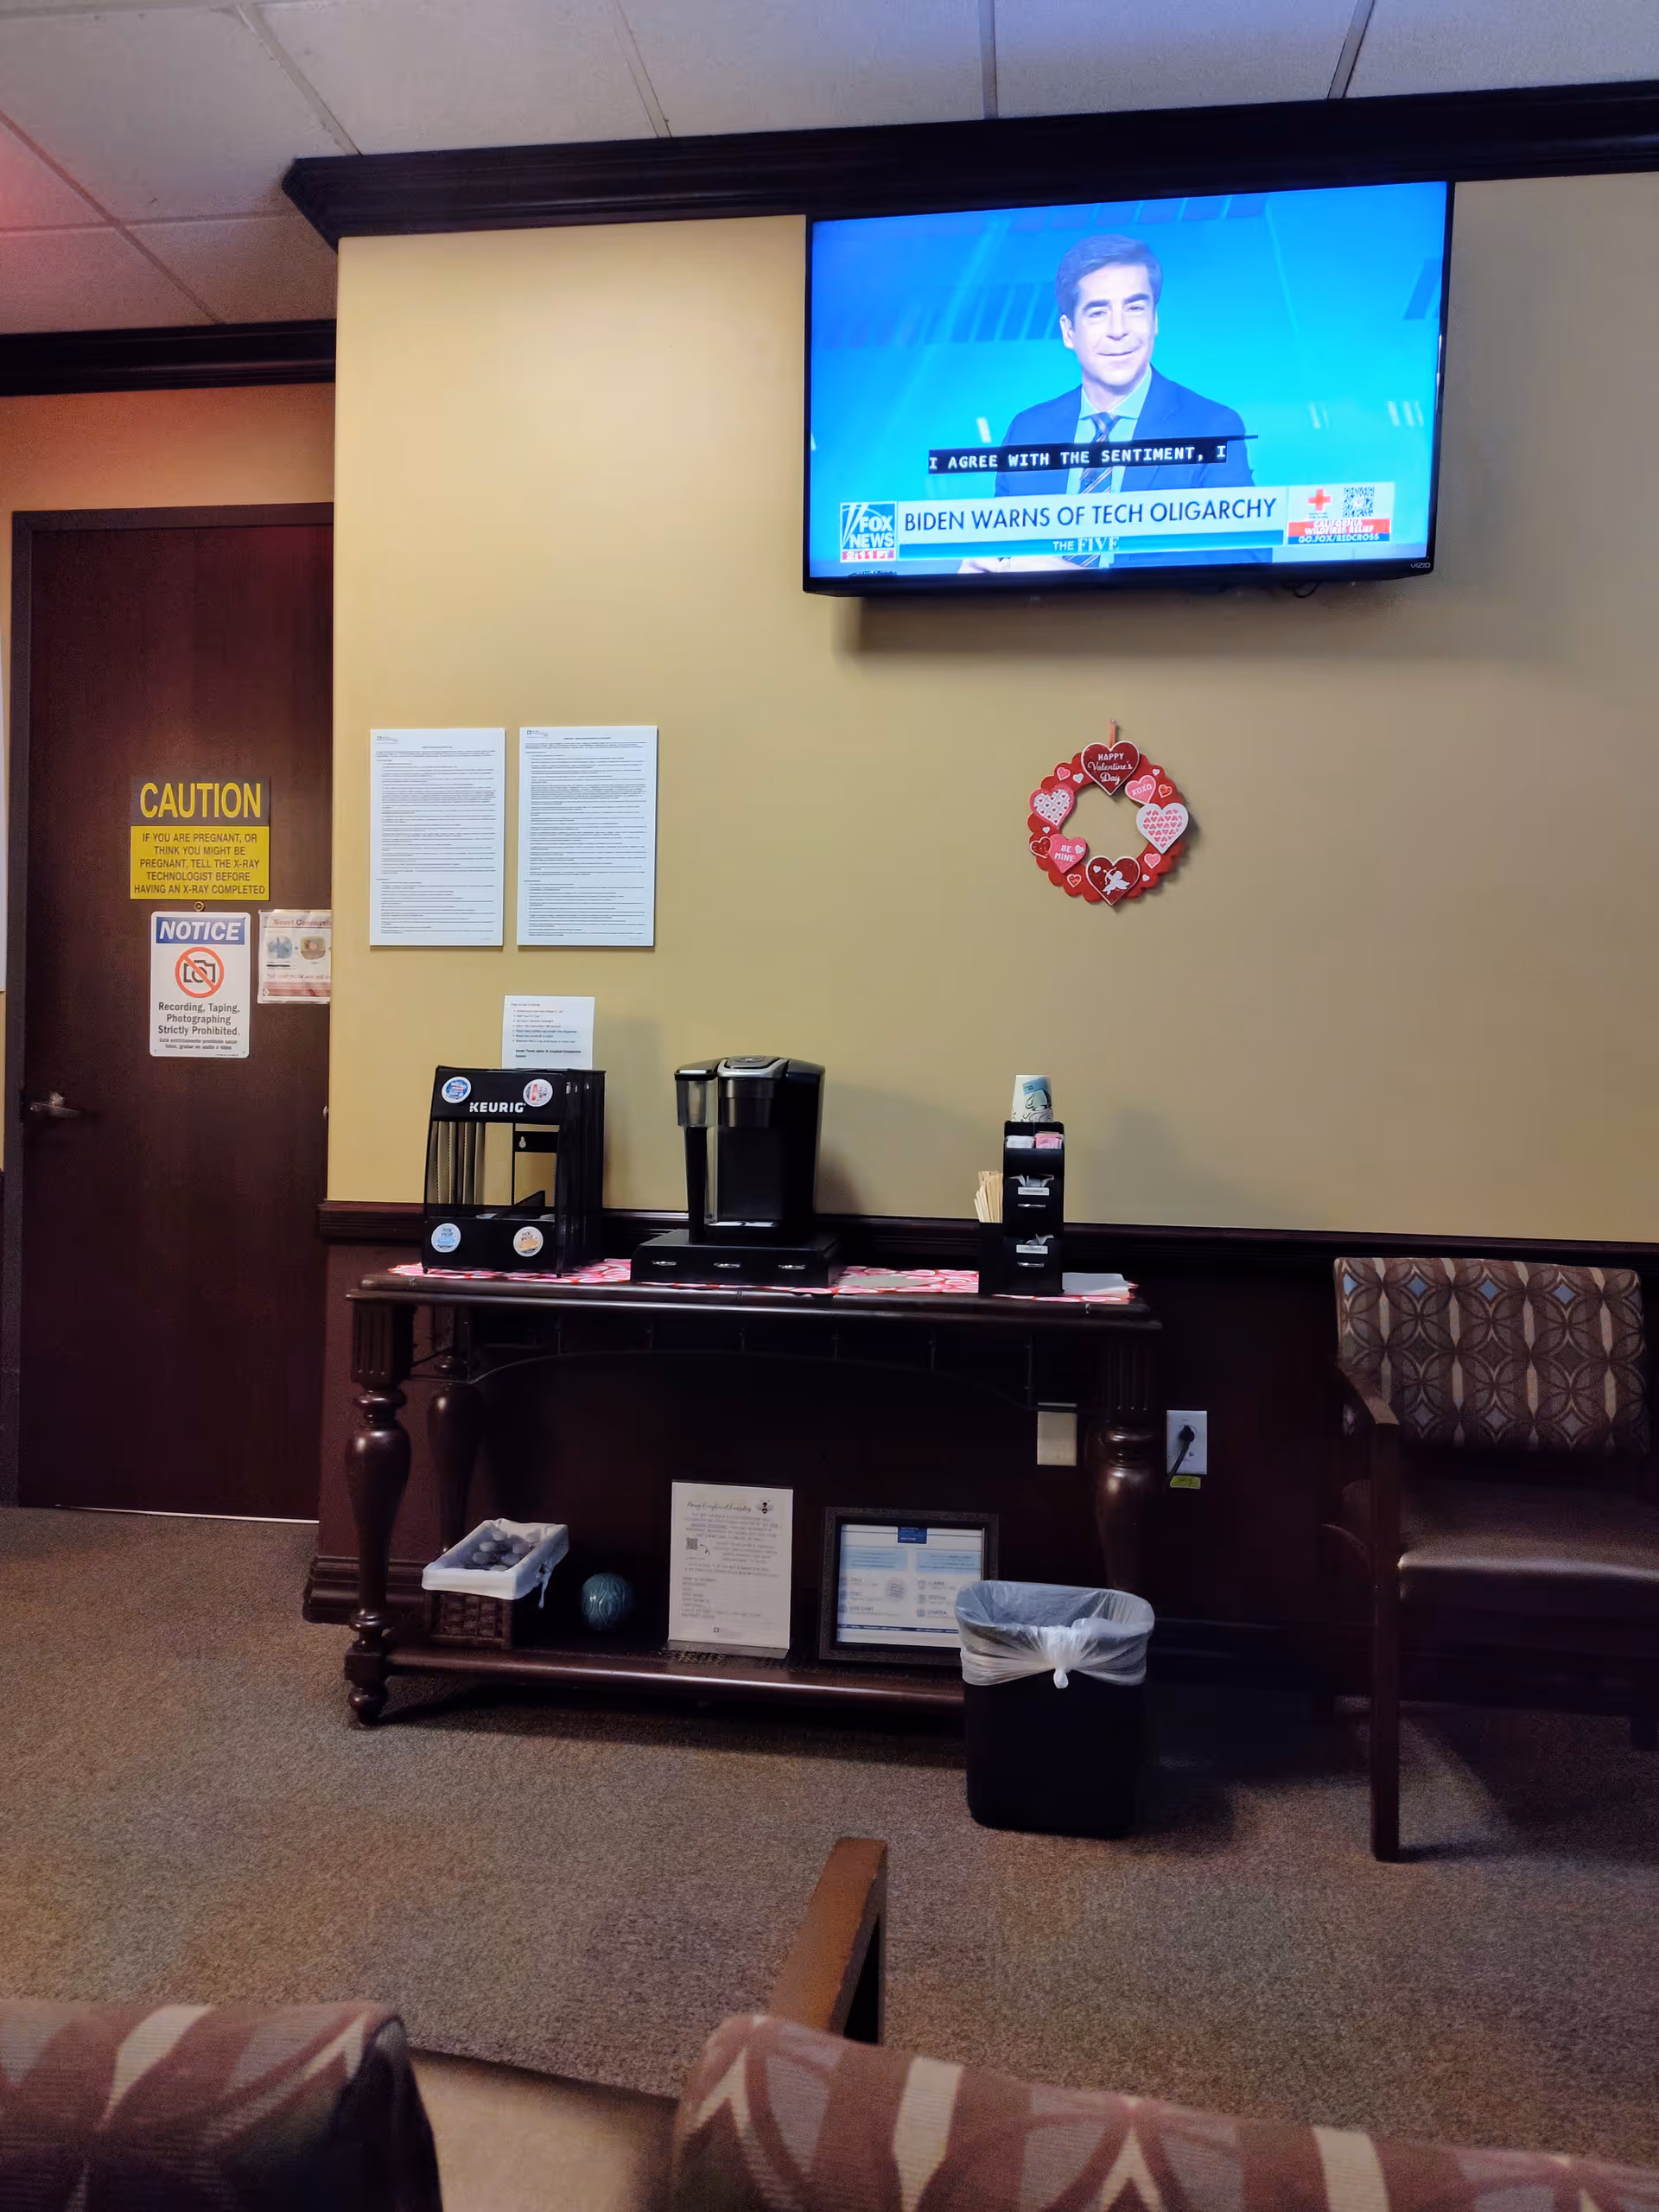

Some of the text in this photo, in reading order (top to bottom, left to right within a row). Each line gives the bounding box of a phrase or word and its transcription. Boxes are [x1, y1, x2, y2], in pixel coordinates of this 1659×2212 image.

[929, 445, 1226, 469] I AGREE WITH THE SENTIMENT, I
[905, 497, 1277, 531] BIDEN WARNS OF TECH OLIGARCHY
[860, 515, 893, 532] FOX
[849, 531, 895, 549] NEWS
[1298, 534, 1380, 543] GO.FOX/REDCROSS
[1052, 537, 1120, 552] THE FIVE
[1097, 753, 1124, 761] HAPPY
[1088, 760, 1133, 770] Valentine's
[1100, 772, 1121, 785] Day
[1131, 783, 1152, 796] XOXO
[140, 782, 261, 818] CAUTION
[143, 833, 257, 843] IF YOU ARE PREGNANT, OR
[154, 846, 245, 855] THINK YOU MIGHT BE
[1054, 853, 1076, 862] MINE
[140, 859, 259, 869] PREGNANT, TELL THE X-RAY
[147, 871, 250, 881] TECHNOLOGIST BEFORE
[134, 885, 265, 894] HAVING AN X-RAY COMPLETED
[159, 920, 241, 941] NOTICE
[158, 1002, 240, 1014] Recording, Taping,
[167, 1014, 231, 1026] Photographing
[158, 1025, 240, 1036] Strictly Prohibited.
[469, 1103, 524, 1113] KEURIG
